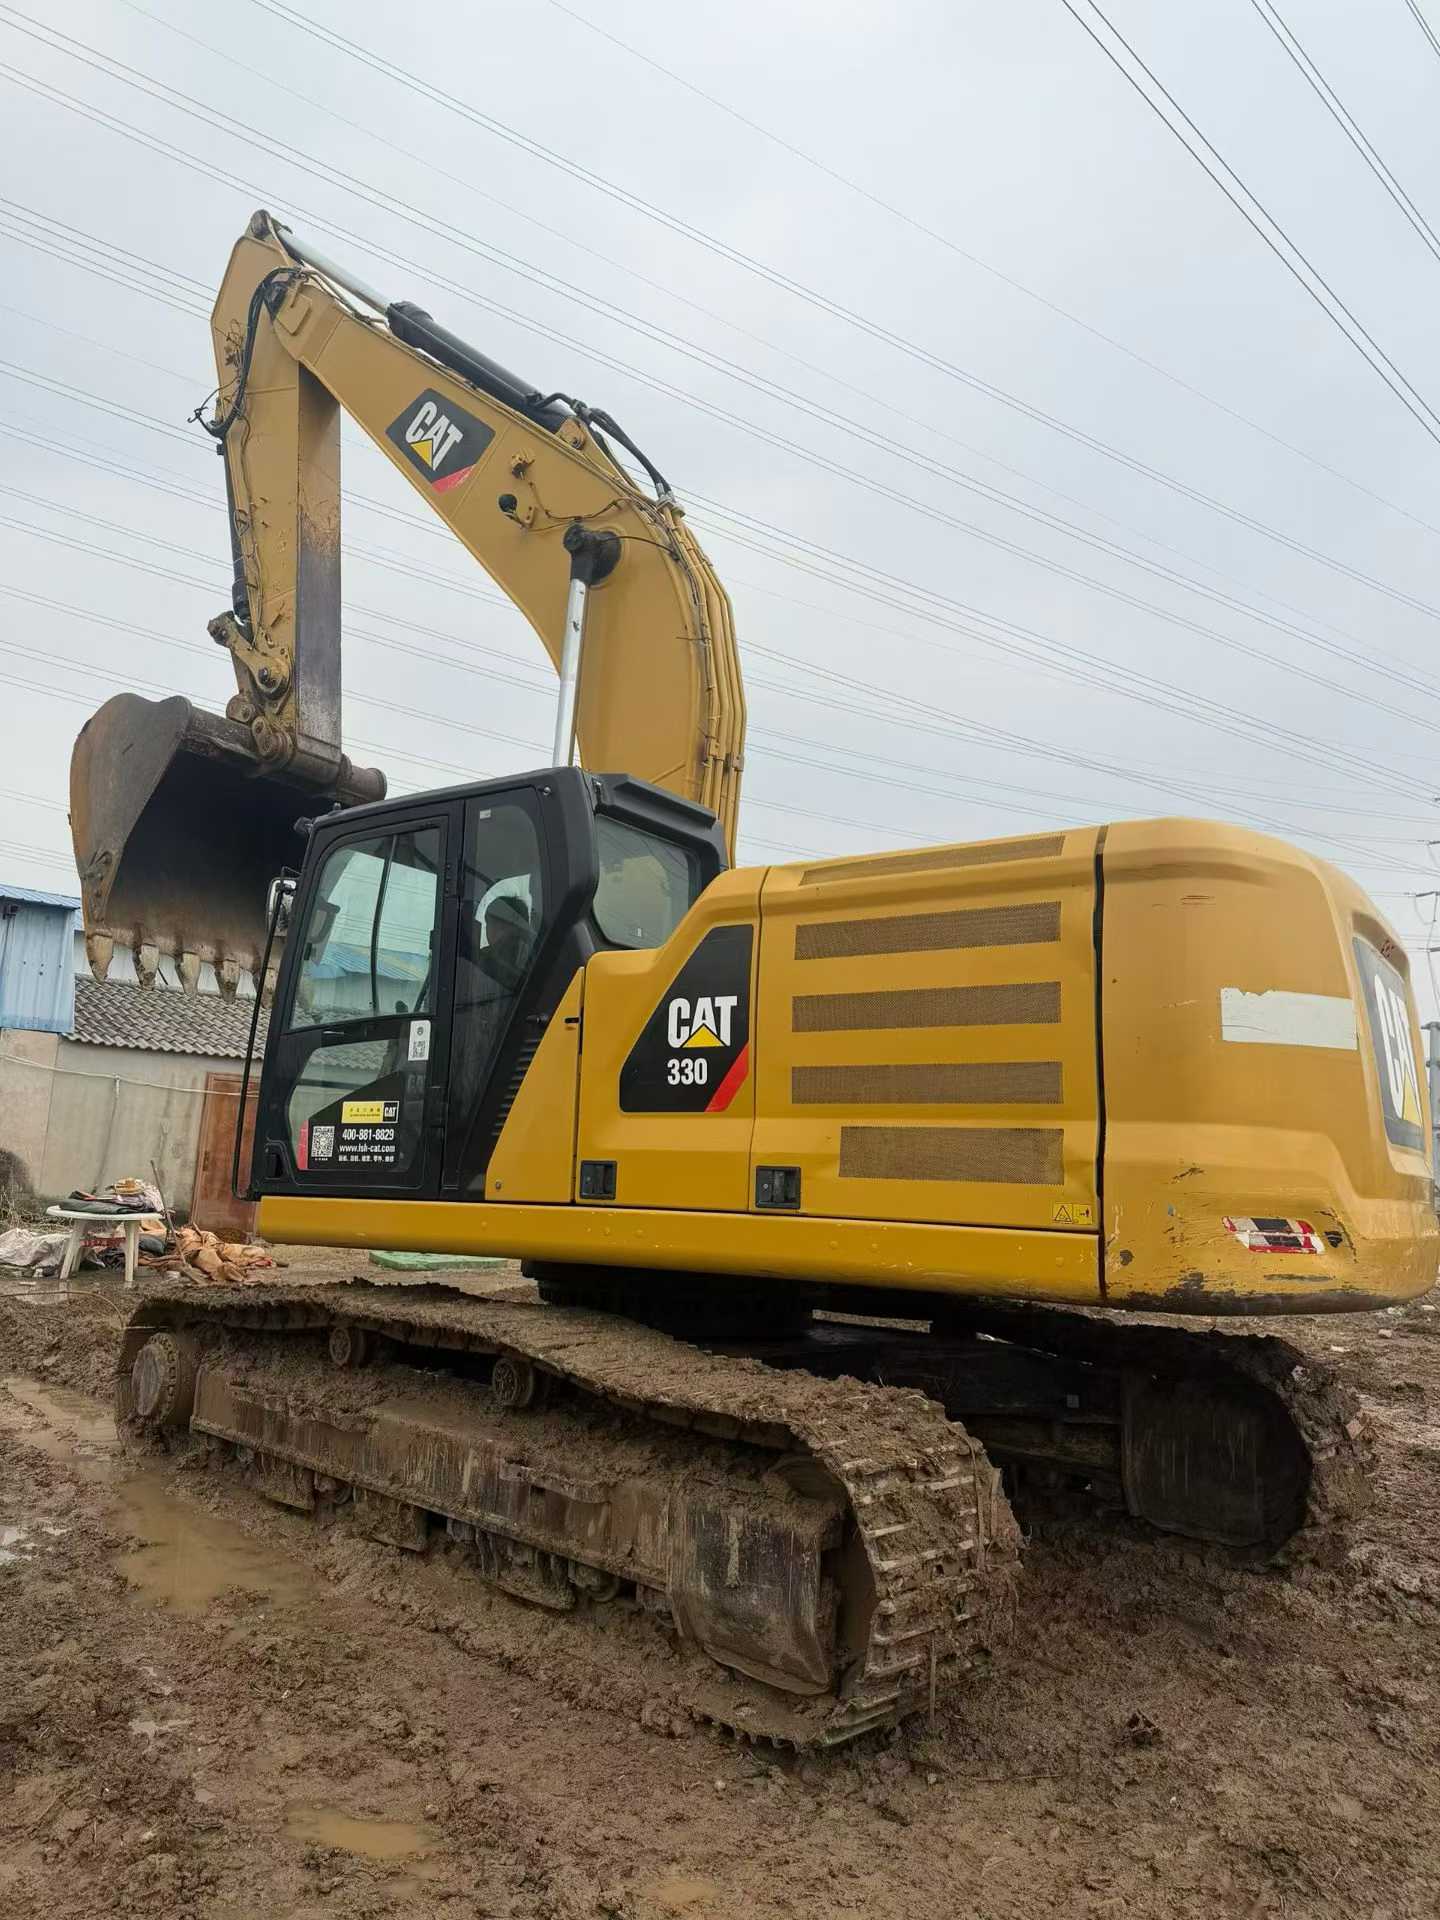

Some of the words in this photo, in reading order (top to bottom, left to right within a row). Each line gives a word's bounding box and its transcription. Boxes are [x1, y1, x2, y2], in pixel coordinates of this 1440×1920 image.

[405, 401, 464, 471] CAT
[667, 995, 738, 1048] CAT
[667, 1058, 708, 1085] 330
[384, 1106, 396, 1117] CAT
[342, 1128, 395, 1141] 400-881-8829
